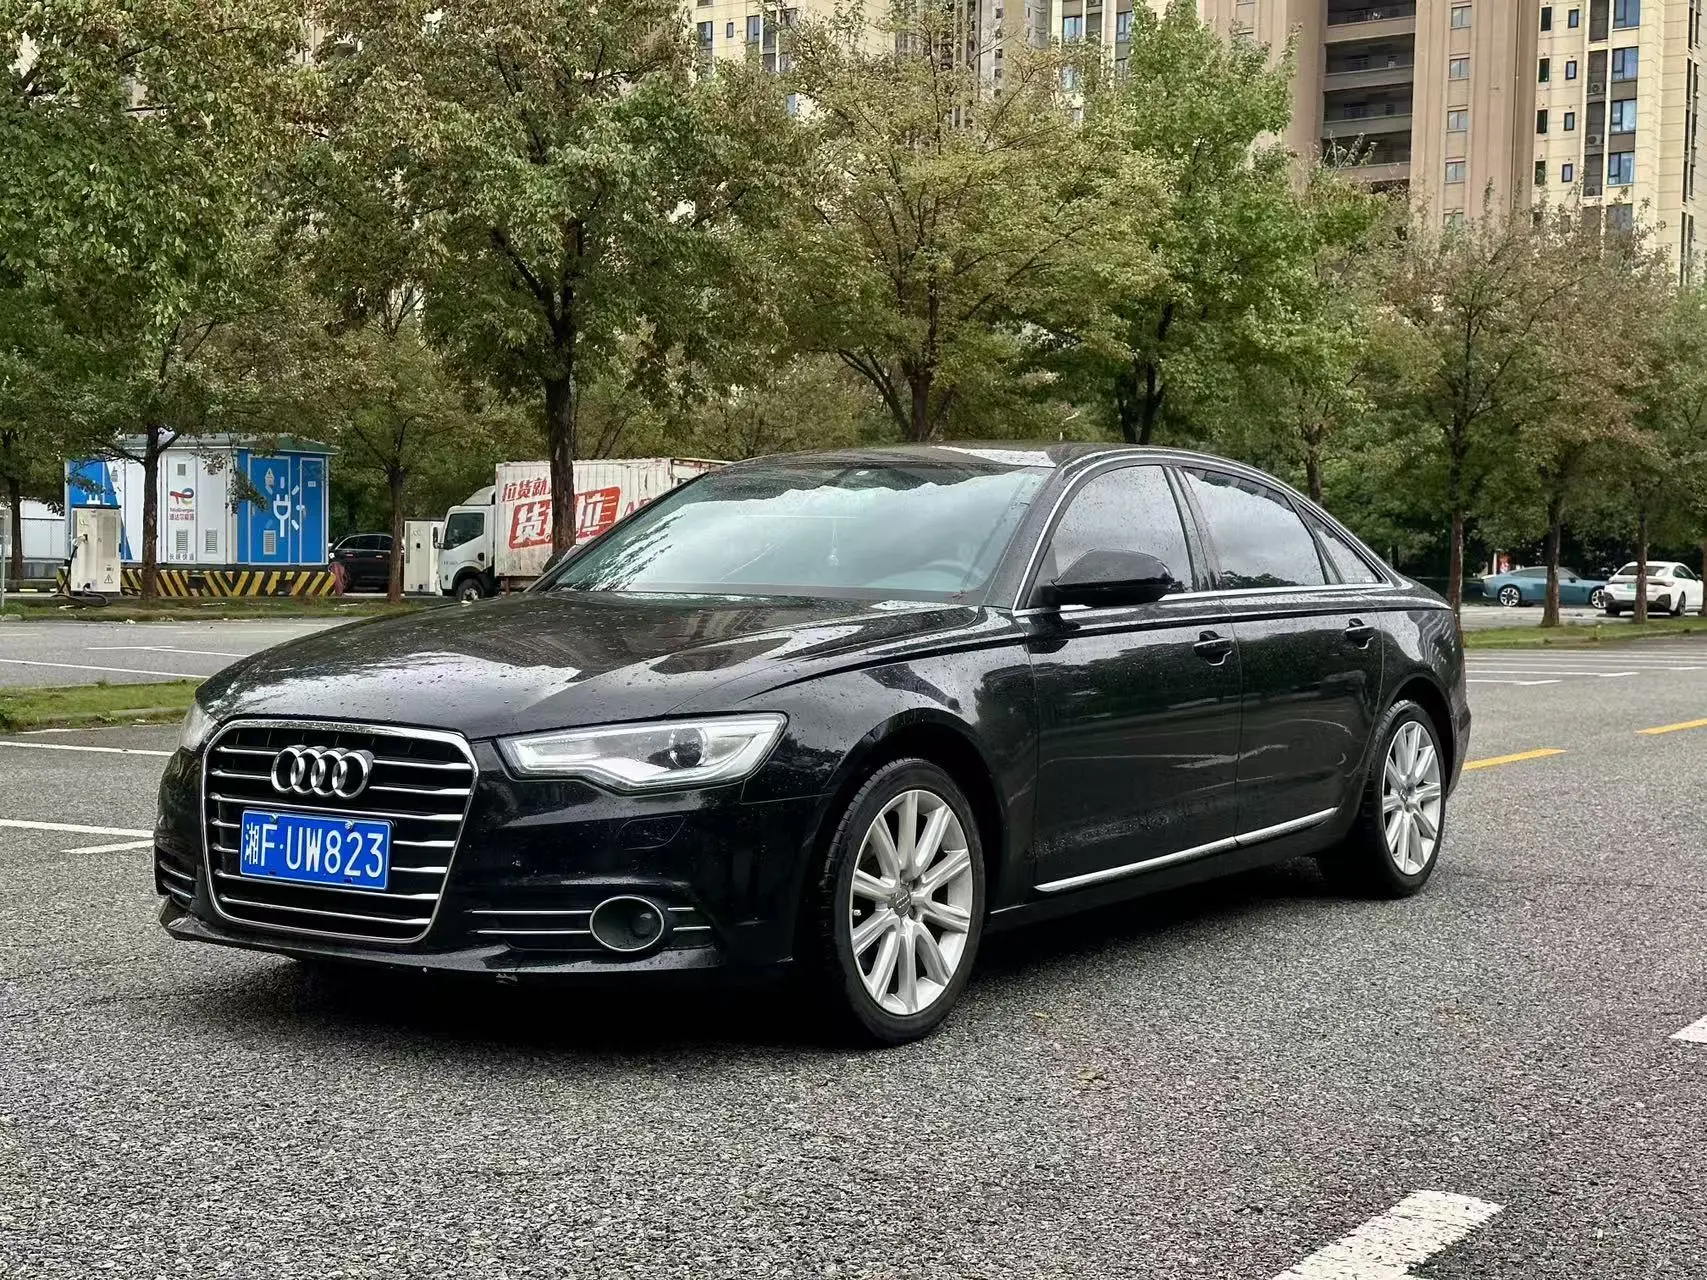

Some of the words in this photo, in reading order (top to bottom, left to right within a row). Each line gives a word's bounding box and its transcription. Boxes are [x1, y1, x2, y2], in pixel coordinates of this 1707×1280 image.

[502, 477, 551, 503] 拉货就
[513, 493, 613, 544] 货拉
[244, 821, 385, 879] 湘F·UW823
